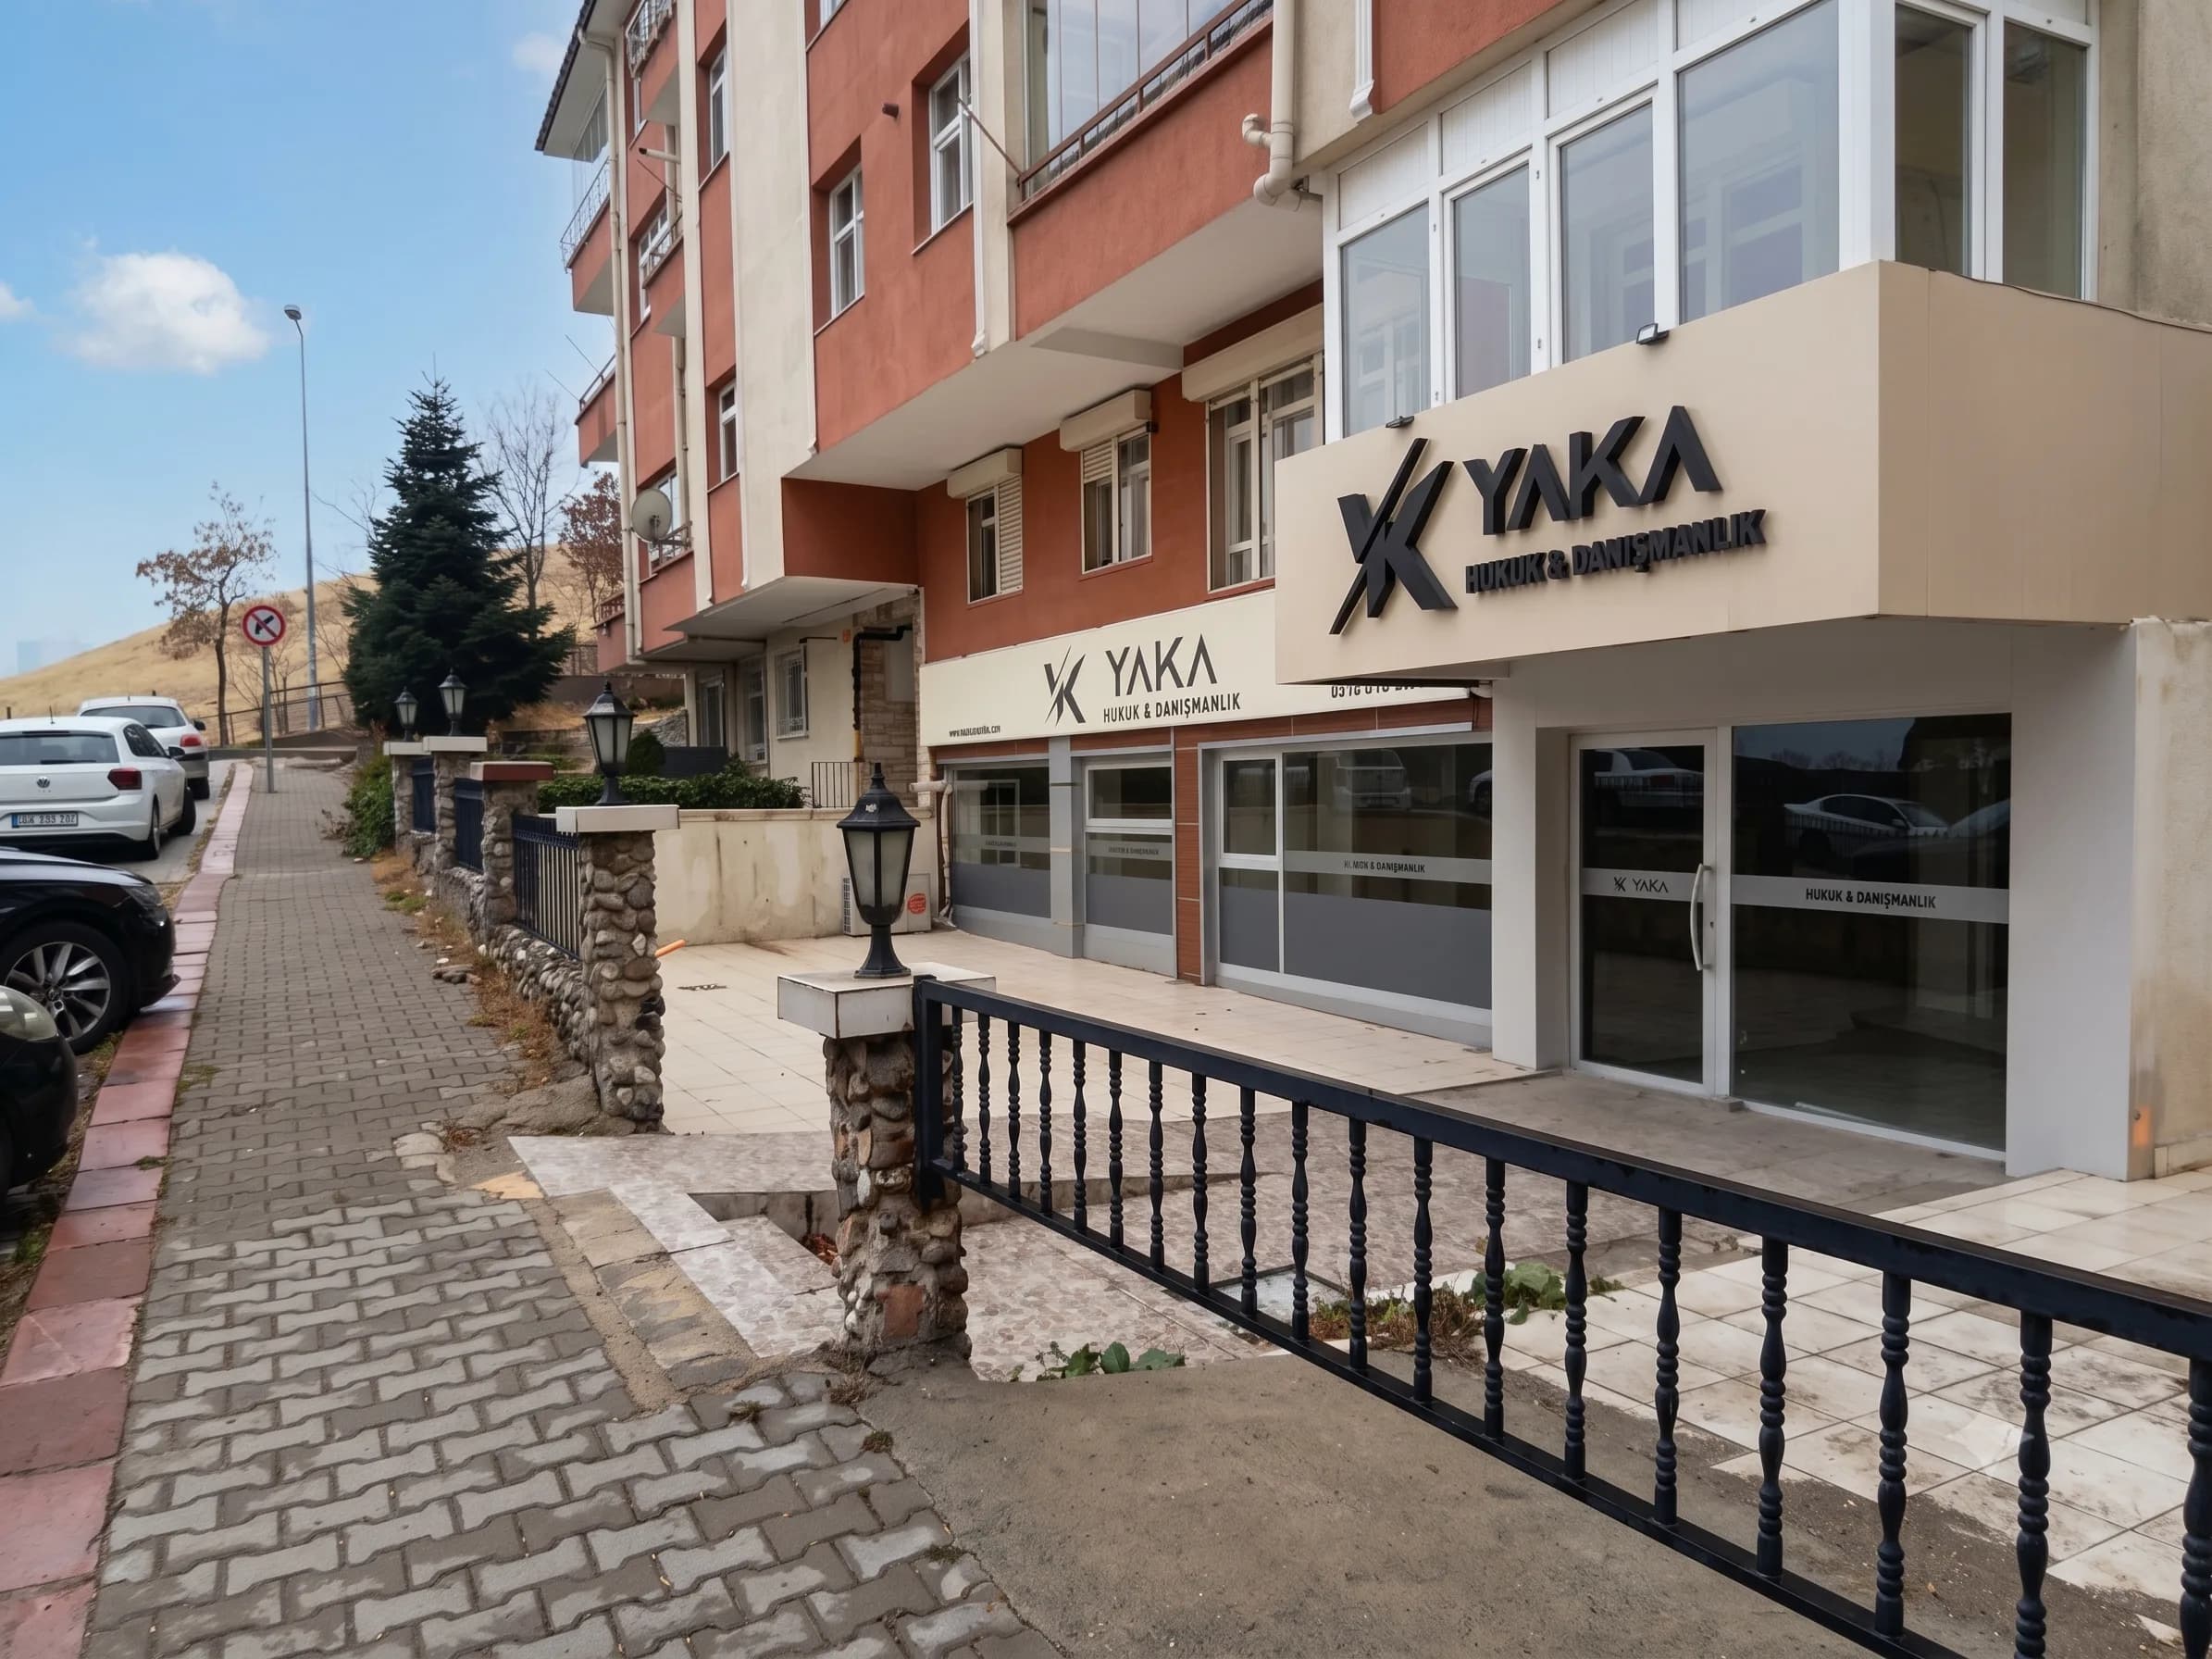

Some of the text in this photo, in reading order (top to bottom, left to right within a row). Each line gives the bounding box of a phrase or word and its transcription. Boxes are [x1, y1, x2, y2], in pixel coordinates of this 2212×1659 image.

[1463, 405, 1722, 535] YAKA
[1466, 509, 1766, 593] HUKUK & DANIŞMANLIK
[1105, 633, 1218, 697] YAKA
[1103, 692, 1241, 723] HUKUK & DANIŞMANLIK
[1632, 878, 1669, 893] YAKA
[1806, 888, 1936, 909] HUKUK & DANIŞMANLIK
